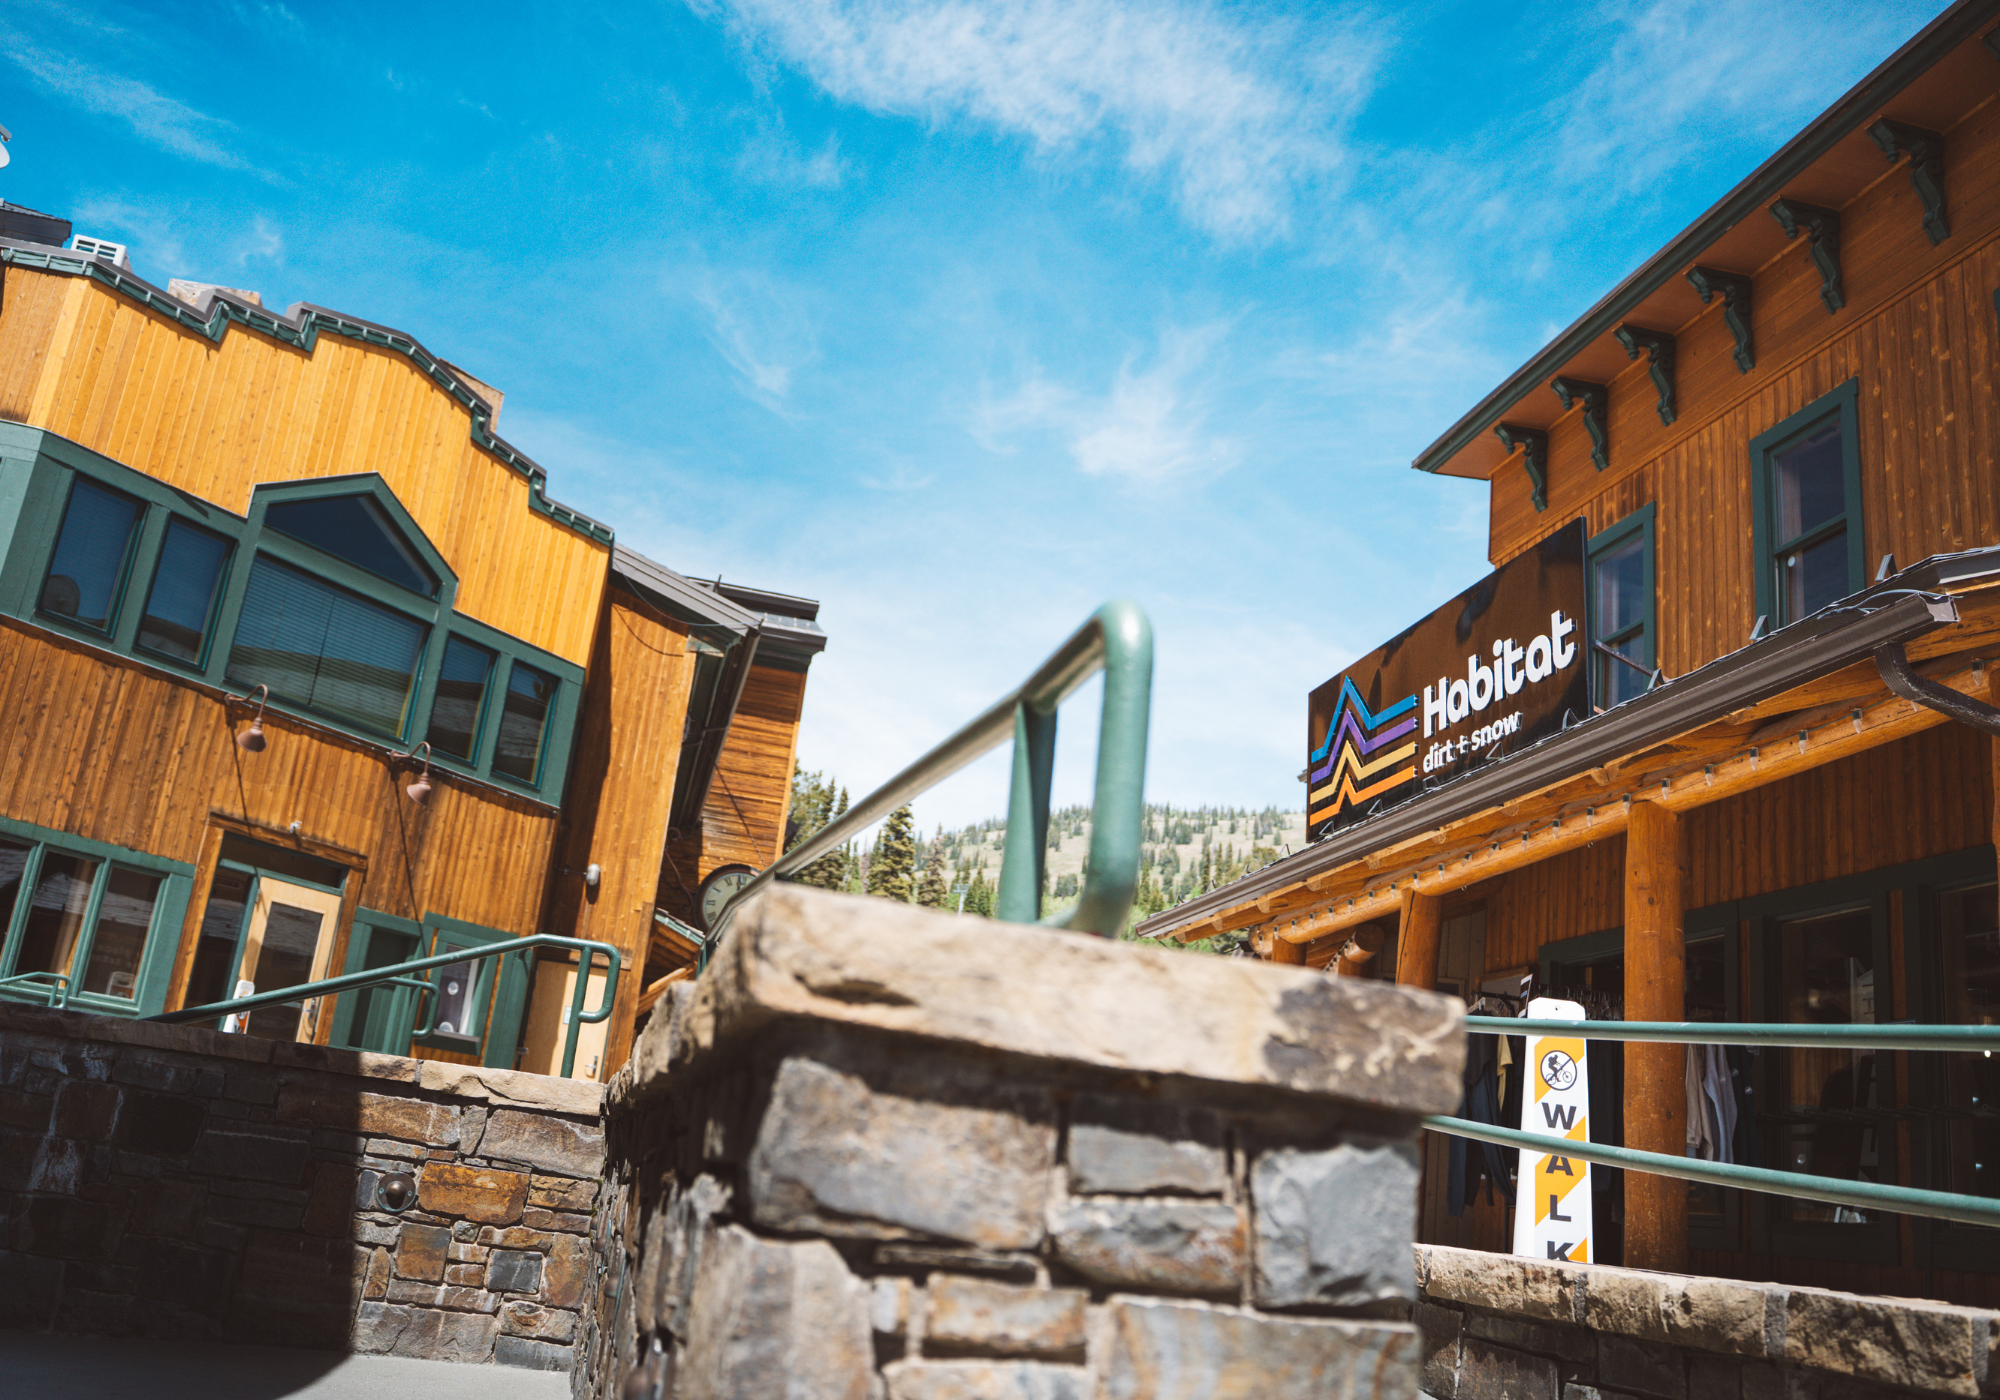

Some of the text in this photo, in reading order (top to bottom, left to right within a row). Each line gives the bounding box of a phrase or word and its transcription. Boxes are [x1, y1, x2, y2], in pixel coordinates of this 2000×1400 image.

[1423, 609, 1576, 739] Habitat
[1422, 739, 1455, 773] dirt
[1471, 710, 1522, 751] snow
[1541, 1101, 1577, 1261] WALK
